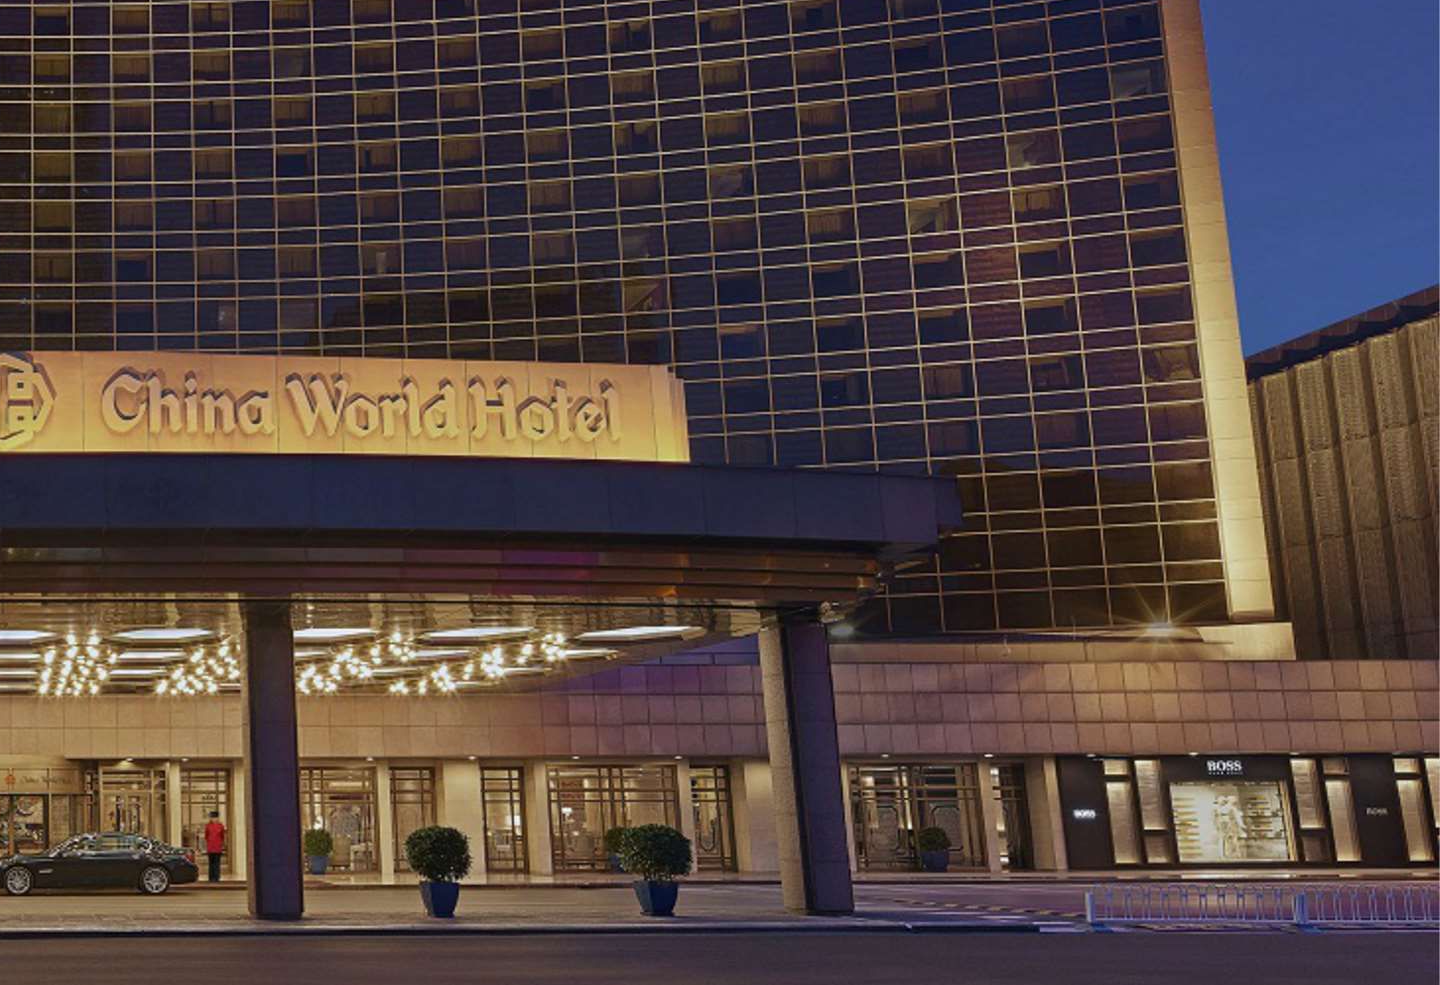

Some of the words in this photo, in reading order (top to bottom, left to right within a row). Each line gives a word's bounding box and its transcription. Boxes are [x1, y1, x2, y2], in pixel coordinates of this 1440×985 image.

[102, 367, 276, 435] China
[285, 372, 459, 438] World
[467, 375, 621, 442] Hotel
[1206, 759, 1242, 771] BOSS
